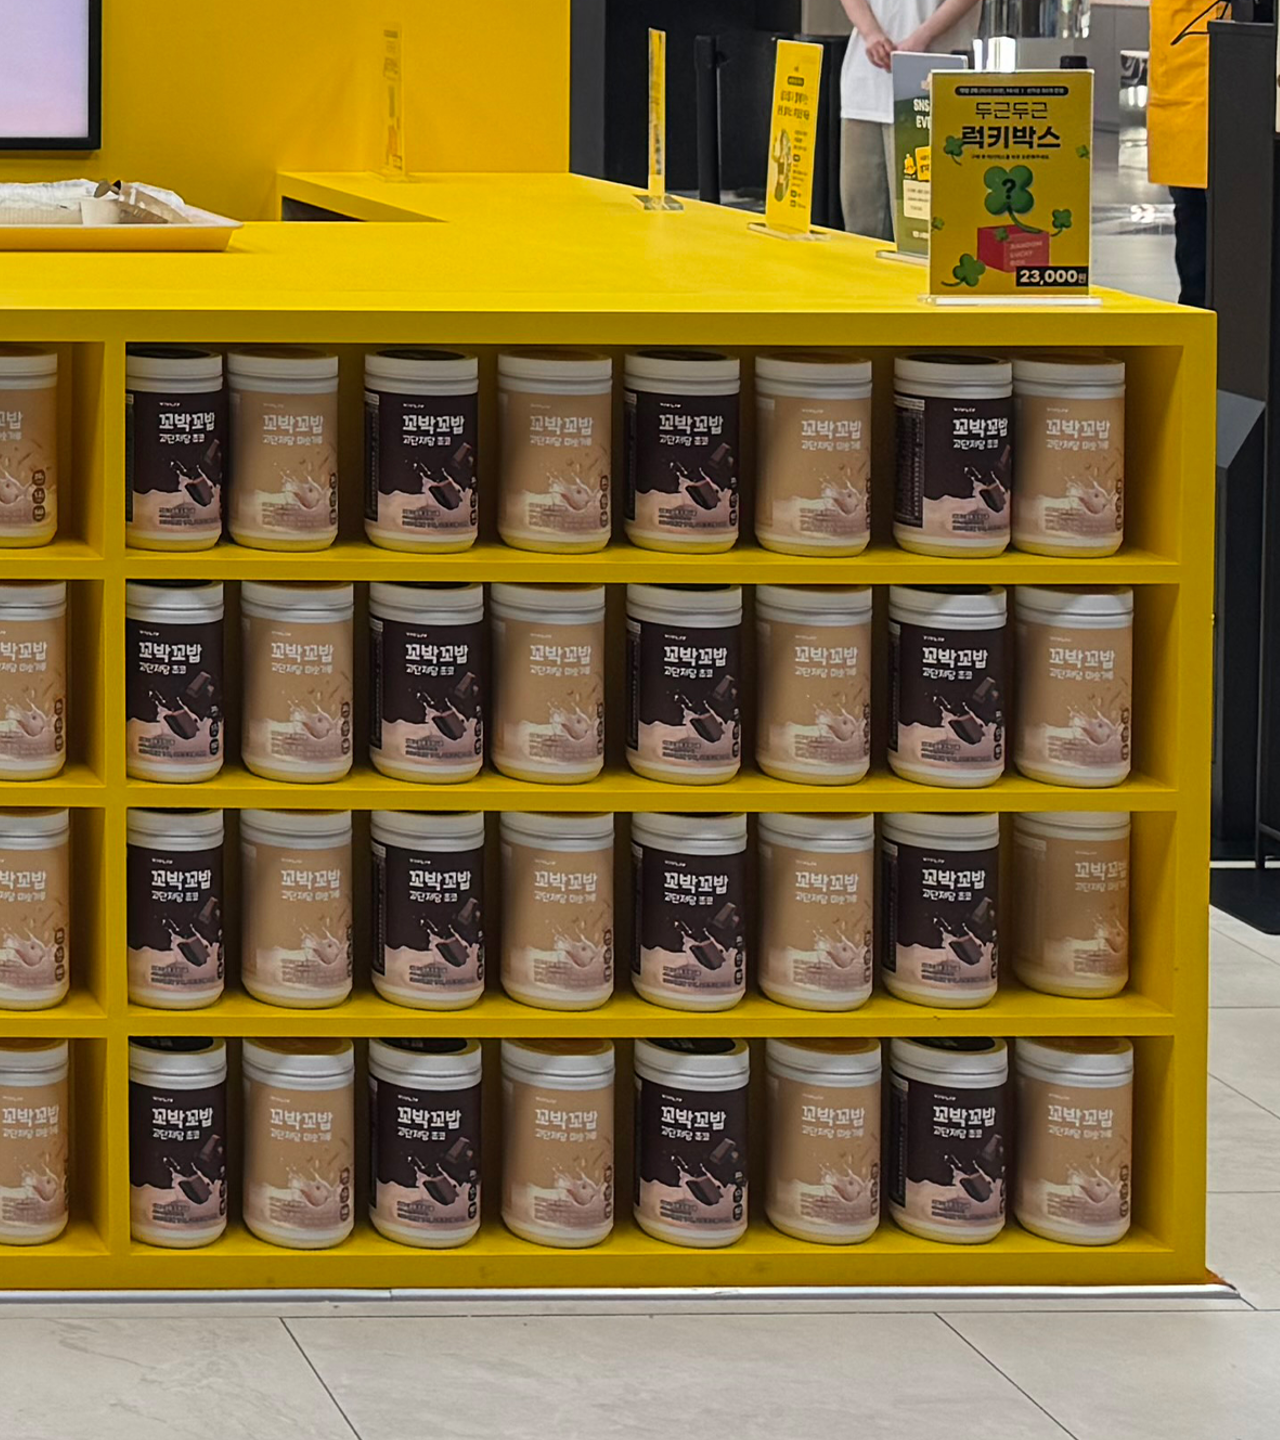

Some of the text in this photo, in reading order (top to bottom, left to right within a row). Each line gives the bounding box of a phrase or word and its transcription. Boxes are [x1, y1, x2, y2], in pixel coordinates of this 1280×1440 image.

[975, 102, 1048, 120] 두근두근
[961, 126, 1061, 149] 럭키박스
[1019, 270, 1087, 286] 23,000원
[159, 412, 215, 432] 꼬박꼬밥
[402, 415, 465, 435] 꼬박꼬밥
[659, 414, 723, 435] 꼬박꼬밥
[953, 418, 1008, 438] 꼬박꼬밥
[139, 642, 202, 663] 꼬박꼬밥
[405, 643, 469, 664] 꼬박꼬밥
[664, 646, 728, 667] 꼬박꼬밥
[922, 647, 988, 669] 꼬박꼬밥
[151, 870, 212, 891] 꼬박꼬밥
[409, 870, 471, 891] 꼬박꼬밥
[664, 872, 729, 894] 꼬박꼬밥
[922, 869, 986, 890] 꼬박꼬밥
[152, 1107, 213, 1129] 꼬박꼬밥
[397, 1106, 462, 1129] 꼬박꼬밥
[661, 1106, 726, 1130] 꼬박꼬밥
[933, 1106, 996, 1127] 꼬박꼬밥
